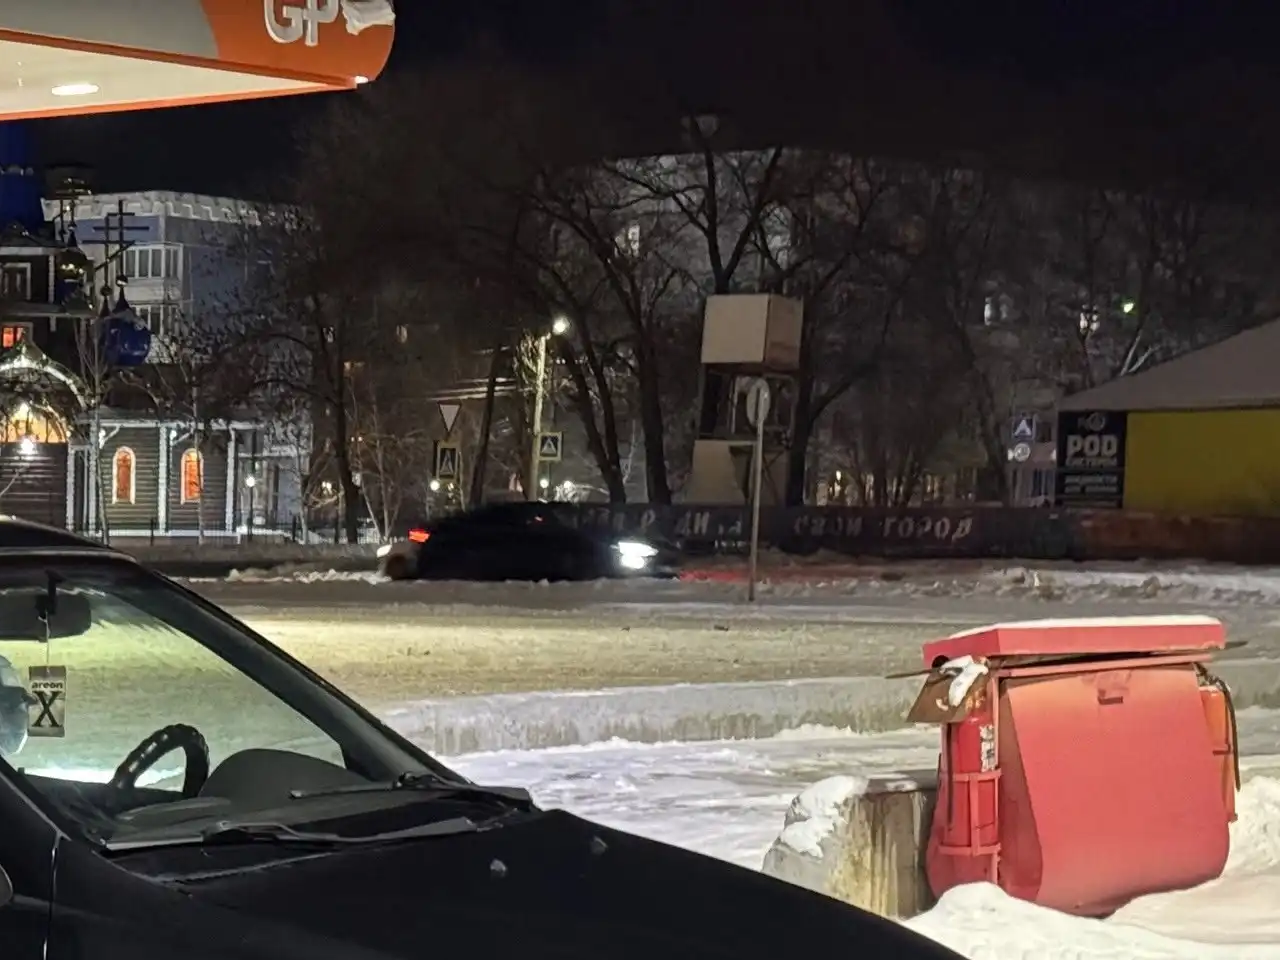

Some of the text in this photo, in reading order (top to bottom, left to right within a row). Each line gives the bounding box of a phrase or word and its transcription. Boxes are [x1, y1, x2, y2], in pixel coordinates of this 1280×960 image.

[1066, 434, 1118, 458] POD
[31, 681, 63, 689] areon
[31, 690, 62, 727] X
